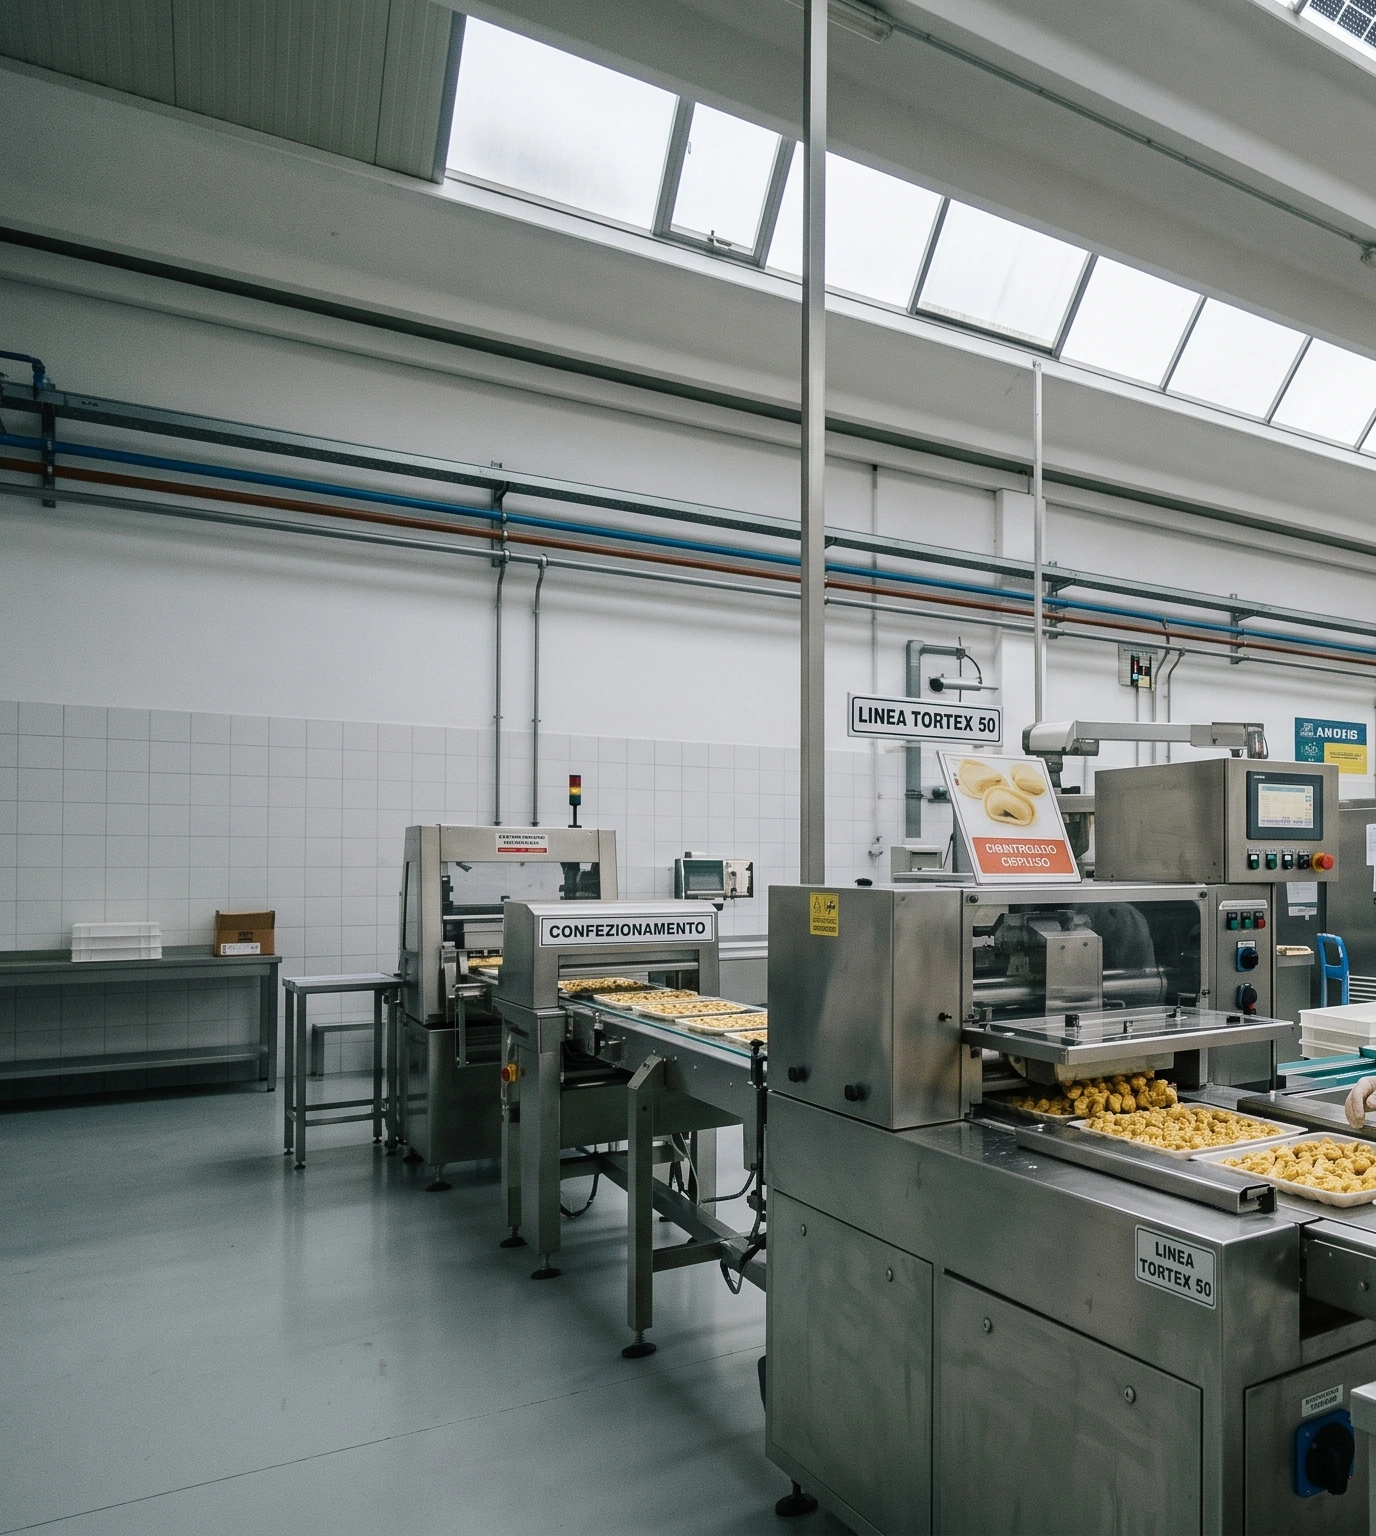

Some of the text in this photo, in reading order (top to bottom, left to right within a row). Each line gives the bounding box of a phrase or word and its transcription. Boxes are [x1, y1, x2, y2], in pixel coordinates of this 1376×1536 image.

[858, 706, 996, 733] LINEA TORTEX 50
[549, 921, 706, 939] CONFEZIONAMENTO
[1155, 1241, 1194, 1269] LINEA
[1139, 1257, 1212, 1297] TORTEX 50
